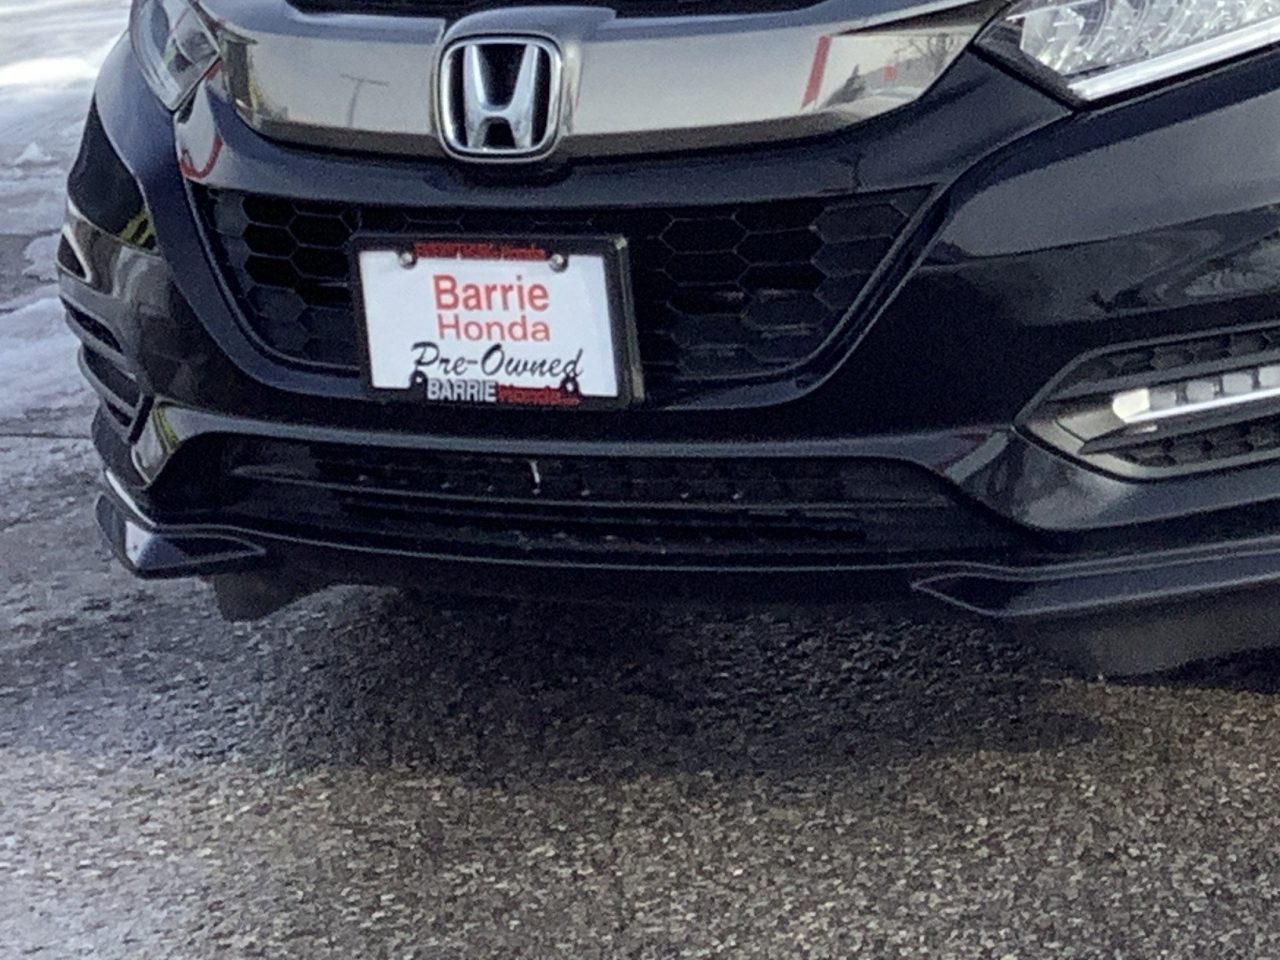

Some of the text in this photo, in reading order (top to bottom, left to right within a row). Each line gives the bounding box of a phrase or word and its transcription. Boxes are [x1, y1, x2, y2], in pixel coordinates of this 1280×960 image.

[432, 274, 550, 311] Barrie
[437, 313, 551, 342] Honda
[410, 341, 584, 378] Pre-Owned
[426, 378, 497, 403] BARRIE
